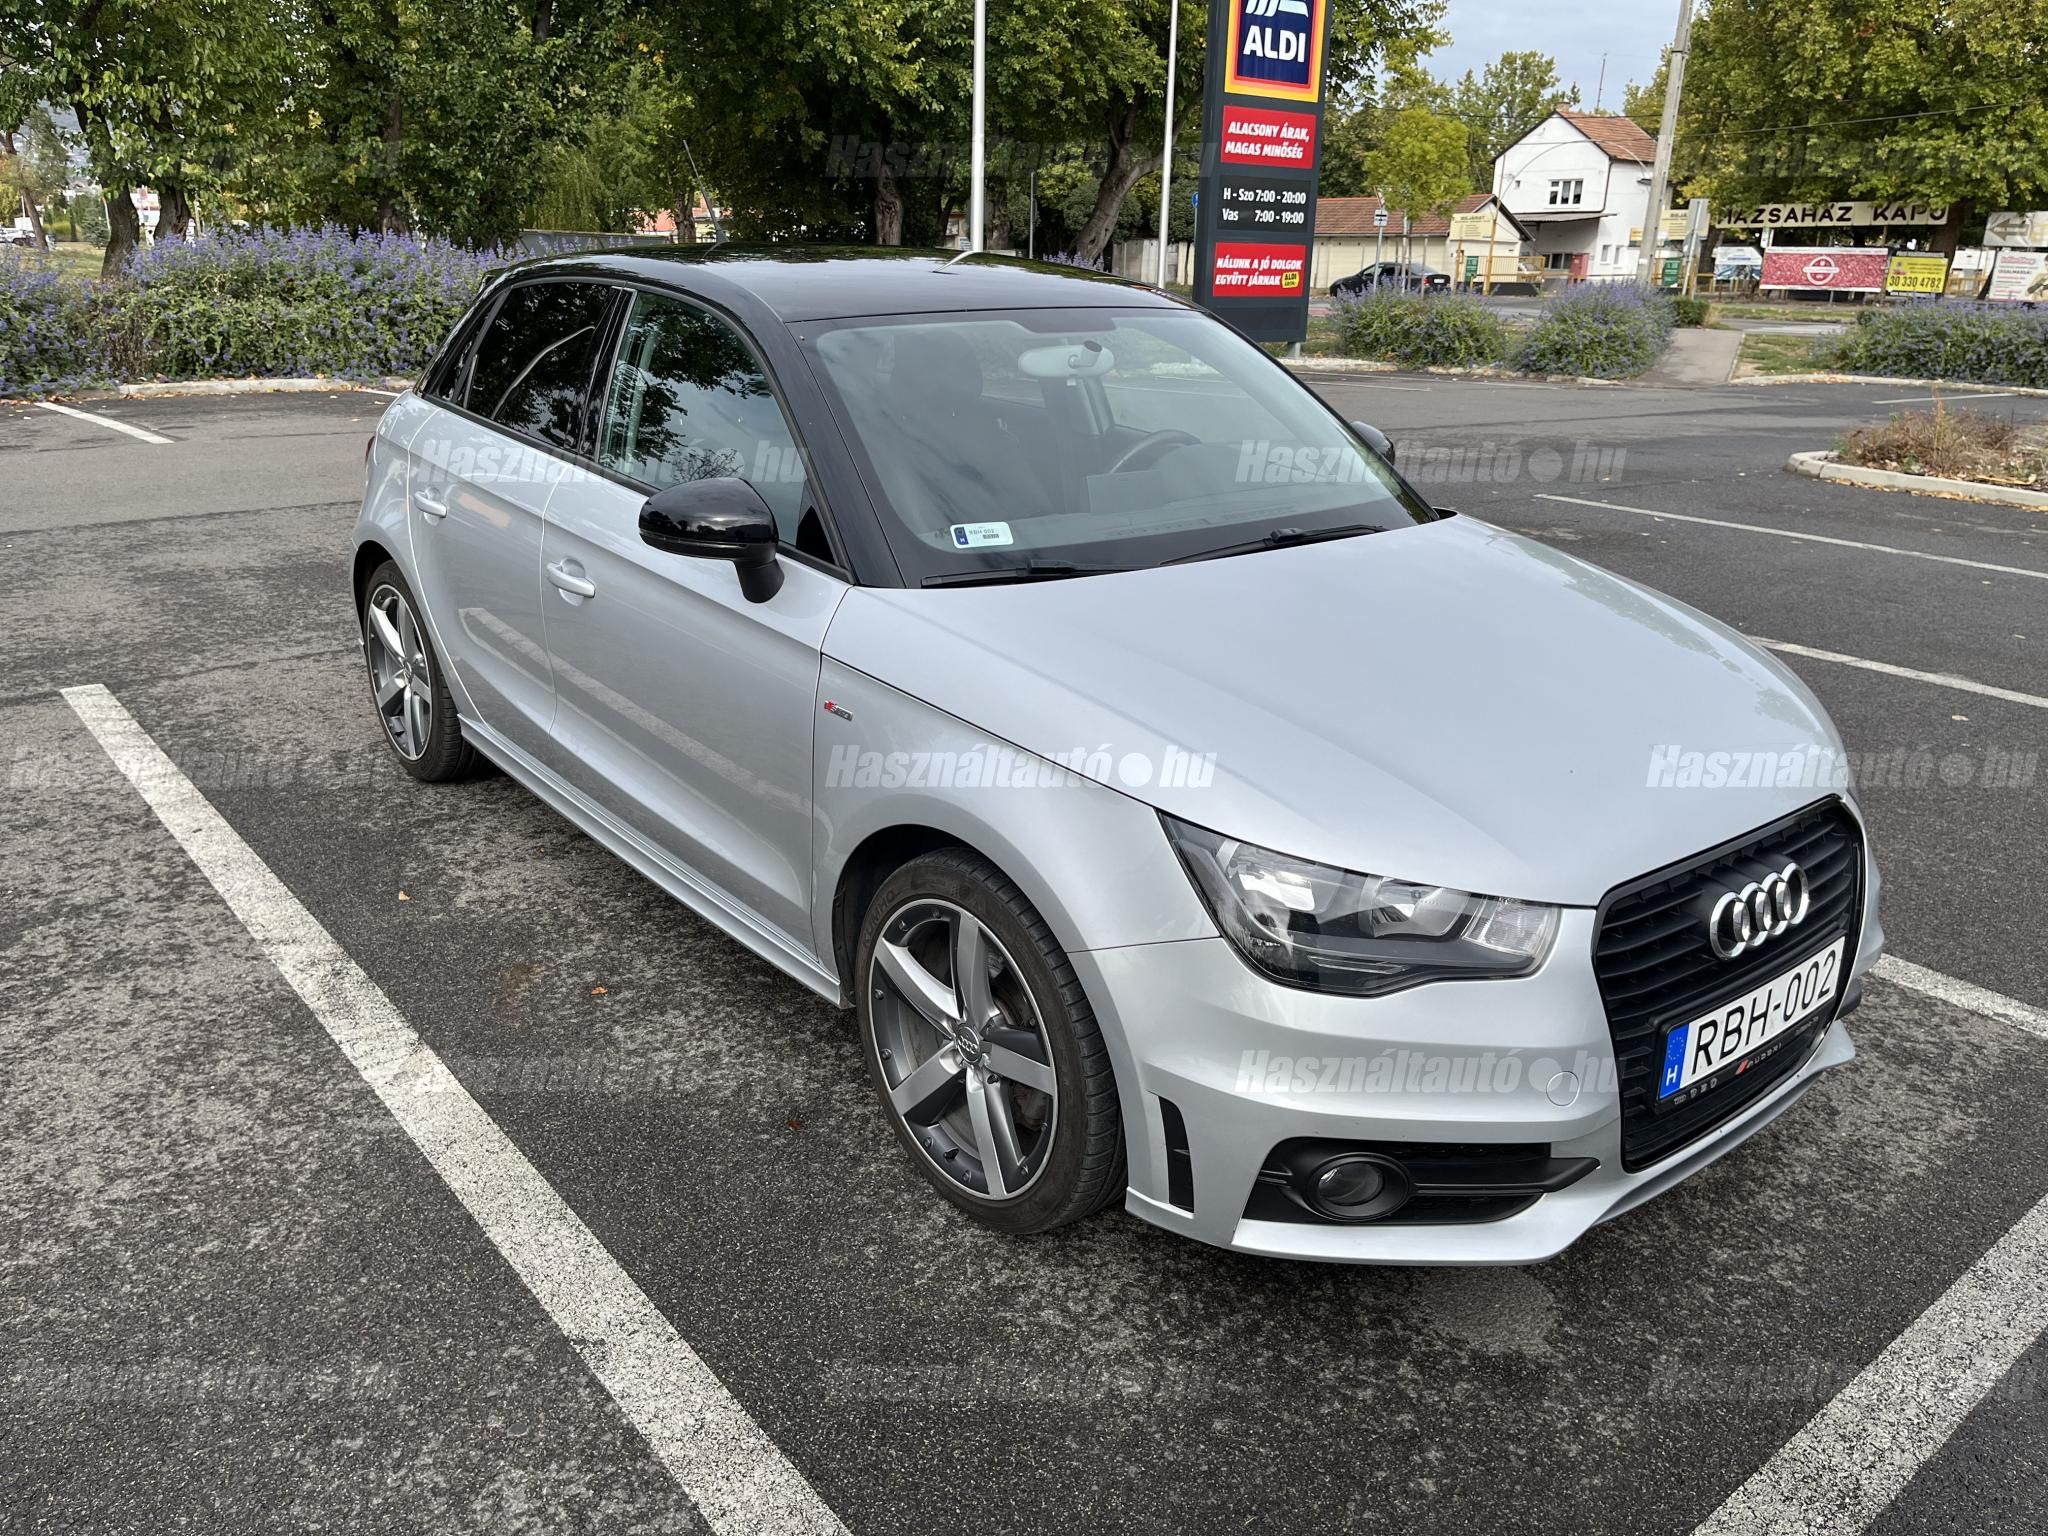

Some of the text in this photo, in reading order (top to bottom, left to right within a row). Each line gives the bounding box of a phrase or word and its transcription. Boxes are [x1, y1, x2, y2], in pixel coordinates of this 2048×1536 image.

[1243, 25, 1306, 63] ALDI
[1228, 121, 1310, 143] ALACSONY ÁRAK,
[1225, 141, 1304, 159] MAGAS MINŐSÉG
[1223, 187, 1231, 200] H
[1238, 188, 1254, 201] Szo
[1255, 189, 1276, 203] 7:00
[1281, 191, 1307, 204] 20:00
[1222, 208, 1239, 221] Vas
[1254, 209, 1275, 223] 7:00
[1281, 211, 1305, 224] 19:00
[1216, 254, 1302, 271] NÁLUNK A JÓ DOLGOK
[1215, 271, 1281, 287] EGYÜTT JÁRNAK
[1692, 949, 1836, 1076] RBH-002
[1665, 1064, 1678, 1087] H
